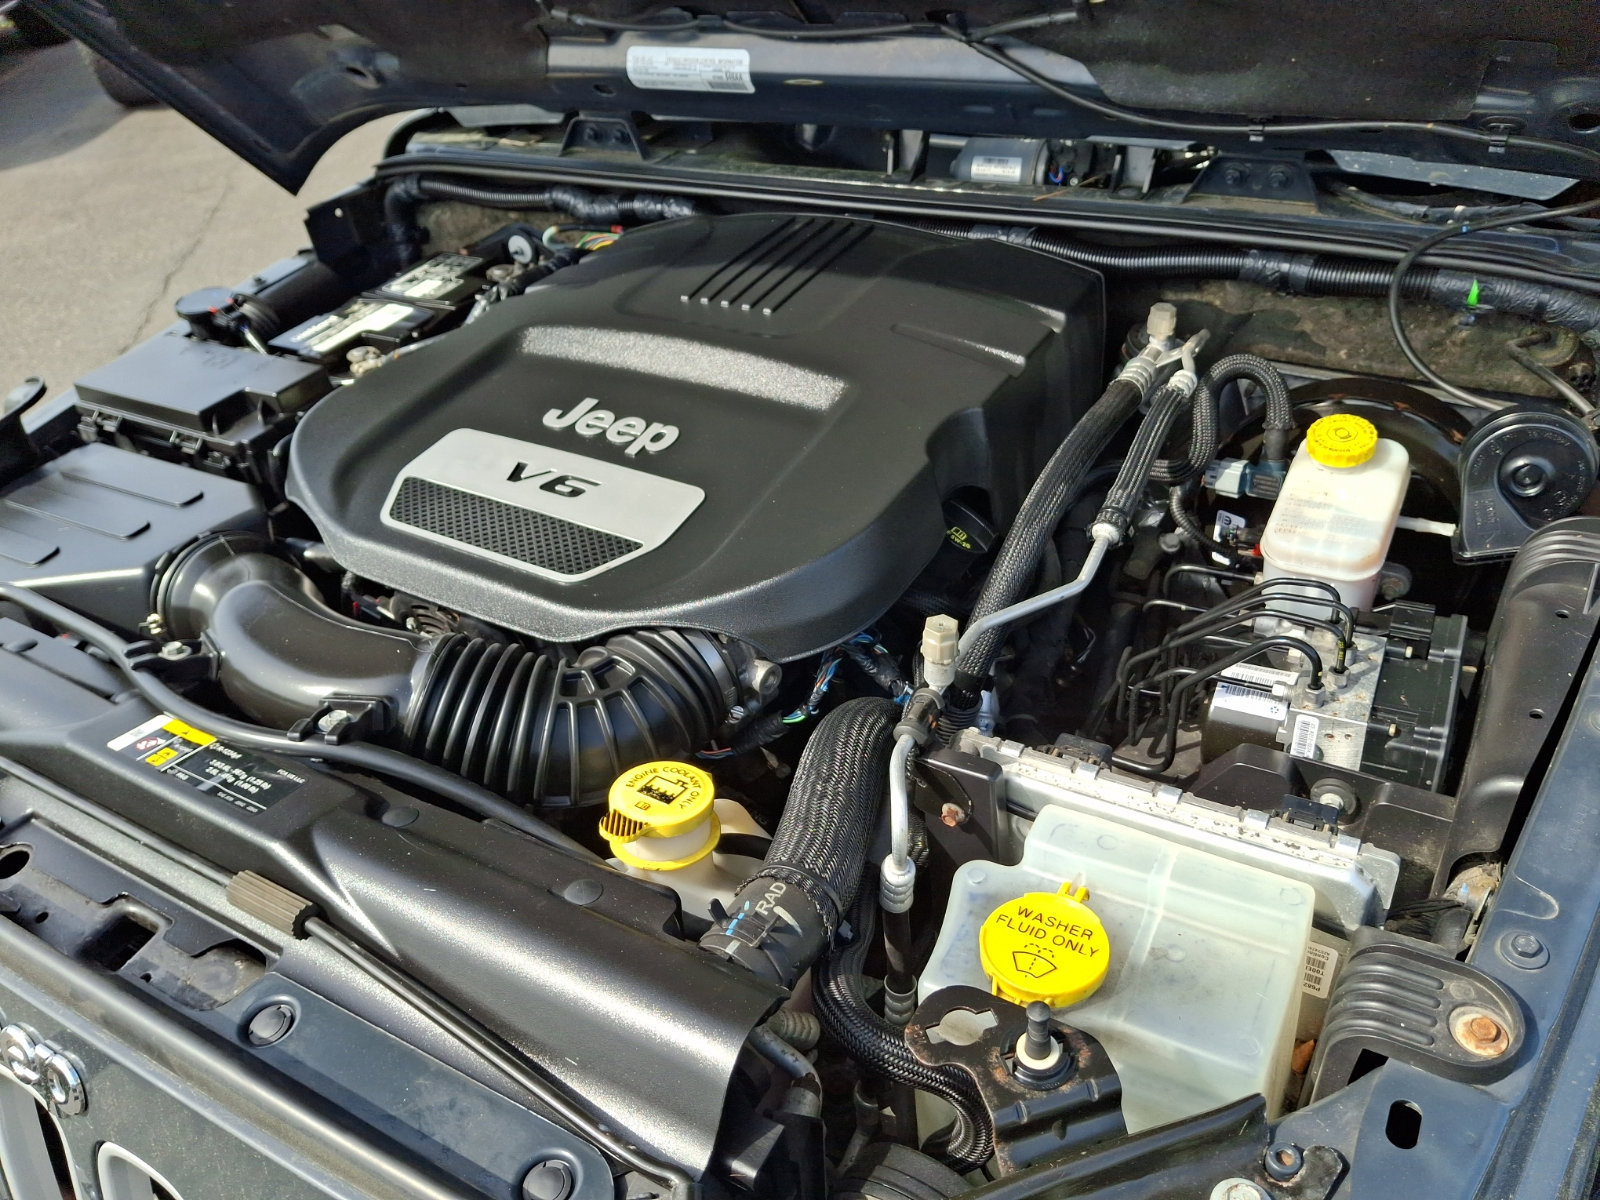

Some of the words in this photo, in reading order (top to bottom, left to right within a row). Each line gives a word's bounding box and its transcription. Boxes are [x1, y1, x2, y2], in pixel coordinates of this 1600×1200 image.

[542, 397, 680, 458] Jeep
[506, 462, 602, 498] V6
[625, 767, 659, 788] ENGINE
[662, 766, 702, 789] COOLANT
[679, 790, 699, 810] ONLY
[755, 882, 787, 916] RAD
[995, 913, 1047, 940] FLUID
[1052, 934, 1100, 958] ONLY
[1017, 905, 1094, 941] WASHER
